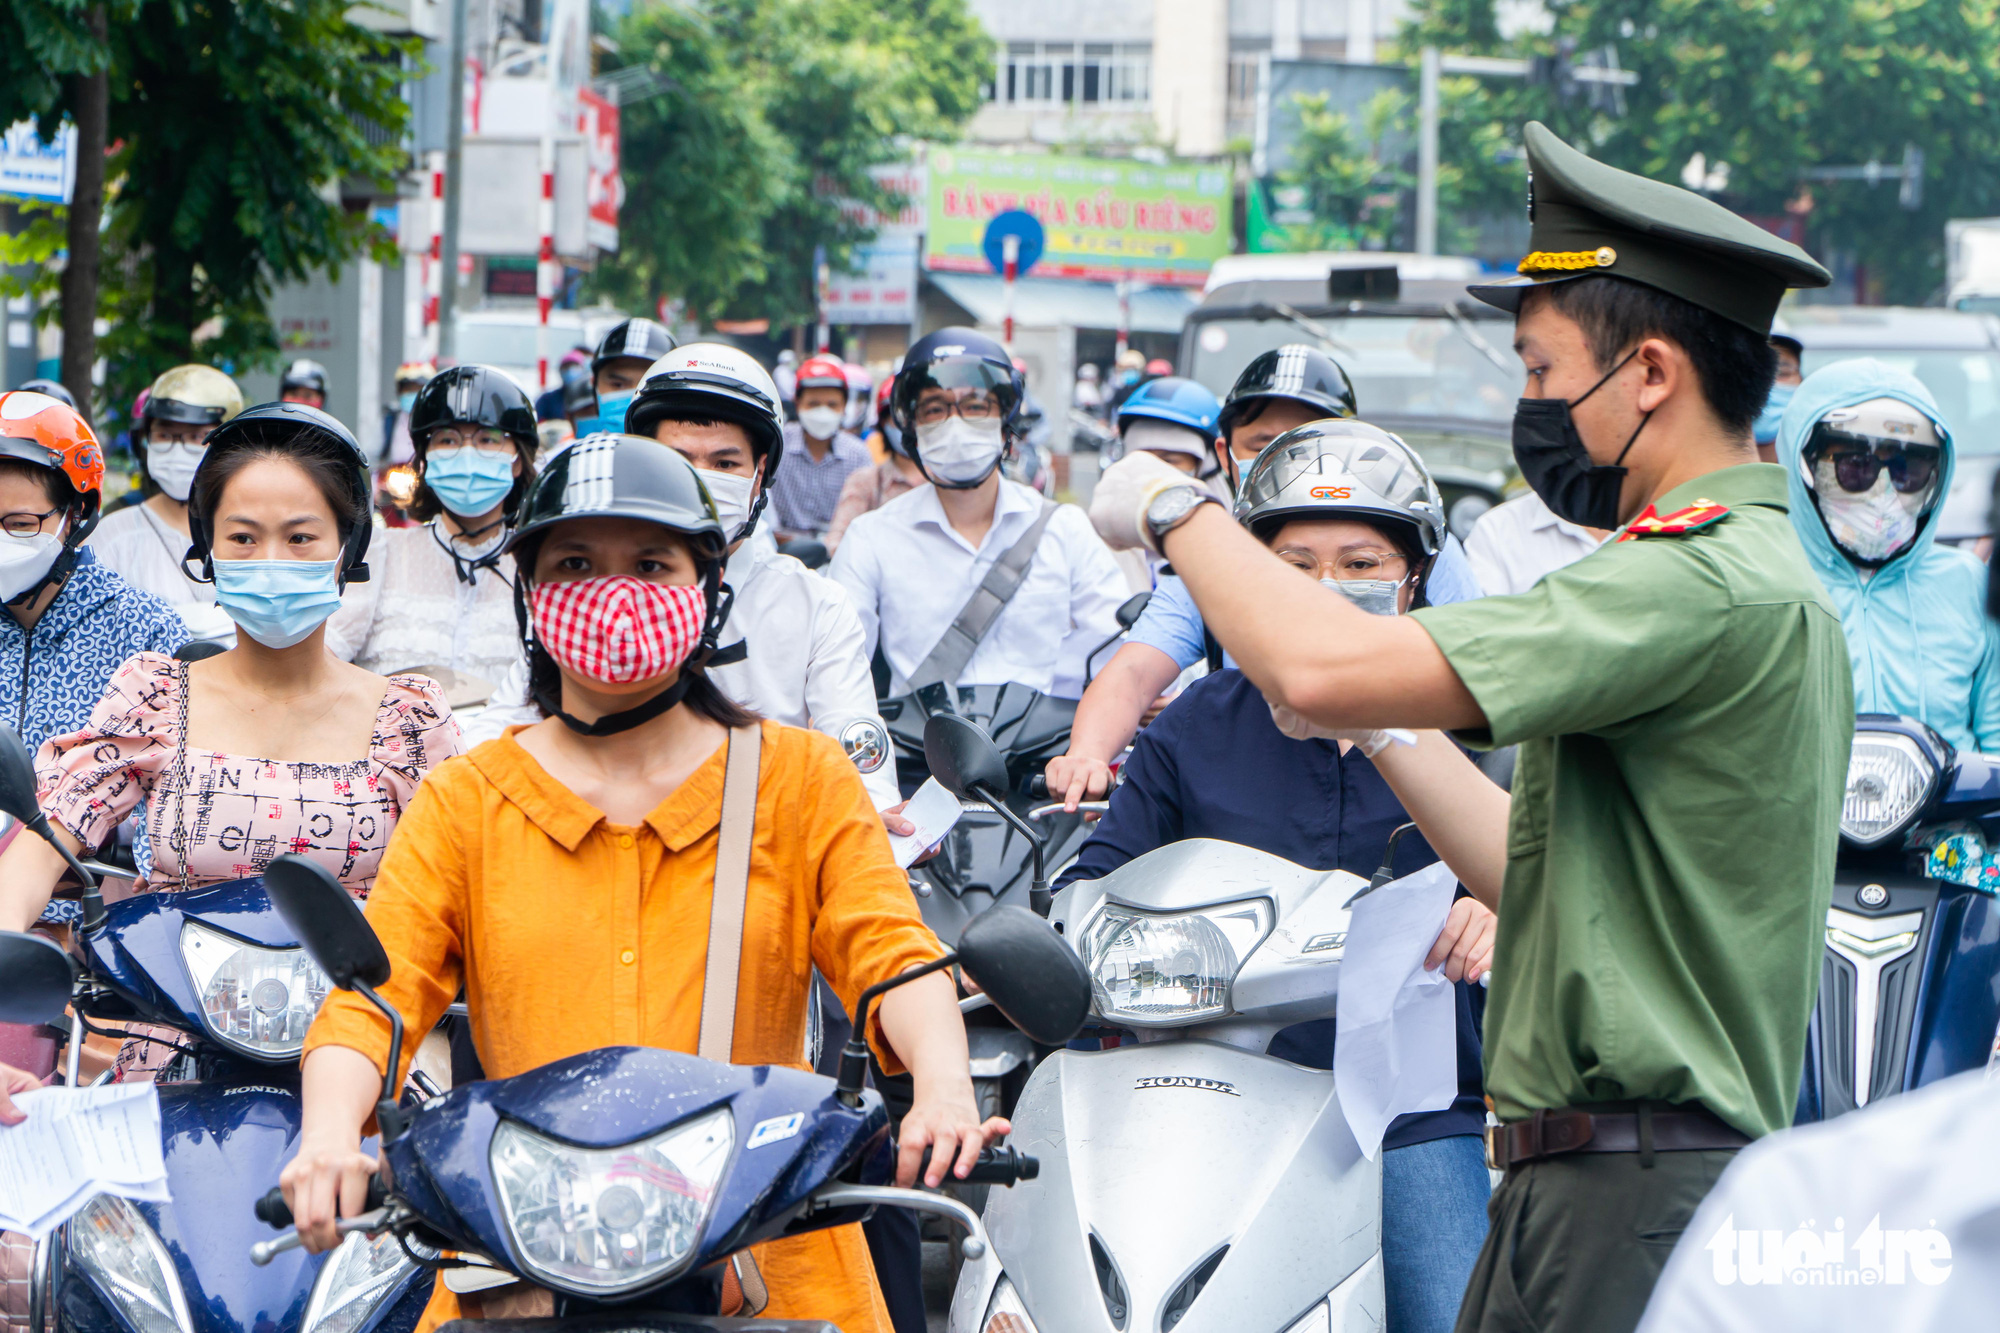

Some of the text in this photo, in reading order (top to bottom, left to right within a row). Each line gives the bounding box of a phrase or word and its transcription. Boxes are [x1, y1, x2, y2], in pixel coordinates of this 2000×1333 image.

[1310, 486, 1351, 499] GRS
[1308, 932, 1348, 947] FI
[223, 1085, 293, 1097] HONDA
[1134, 1076, 1241, 1097] HONDA
